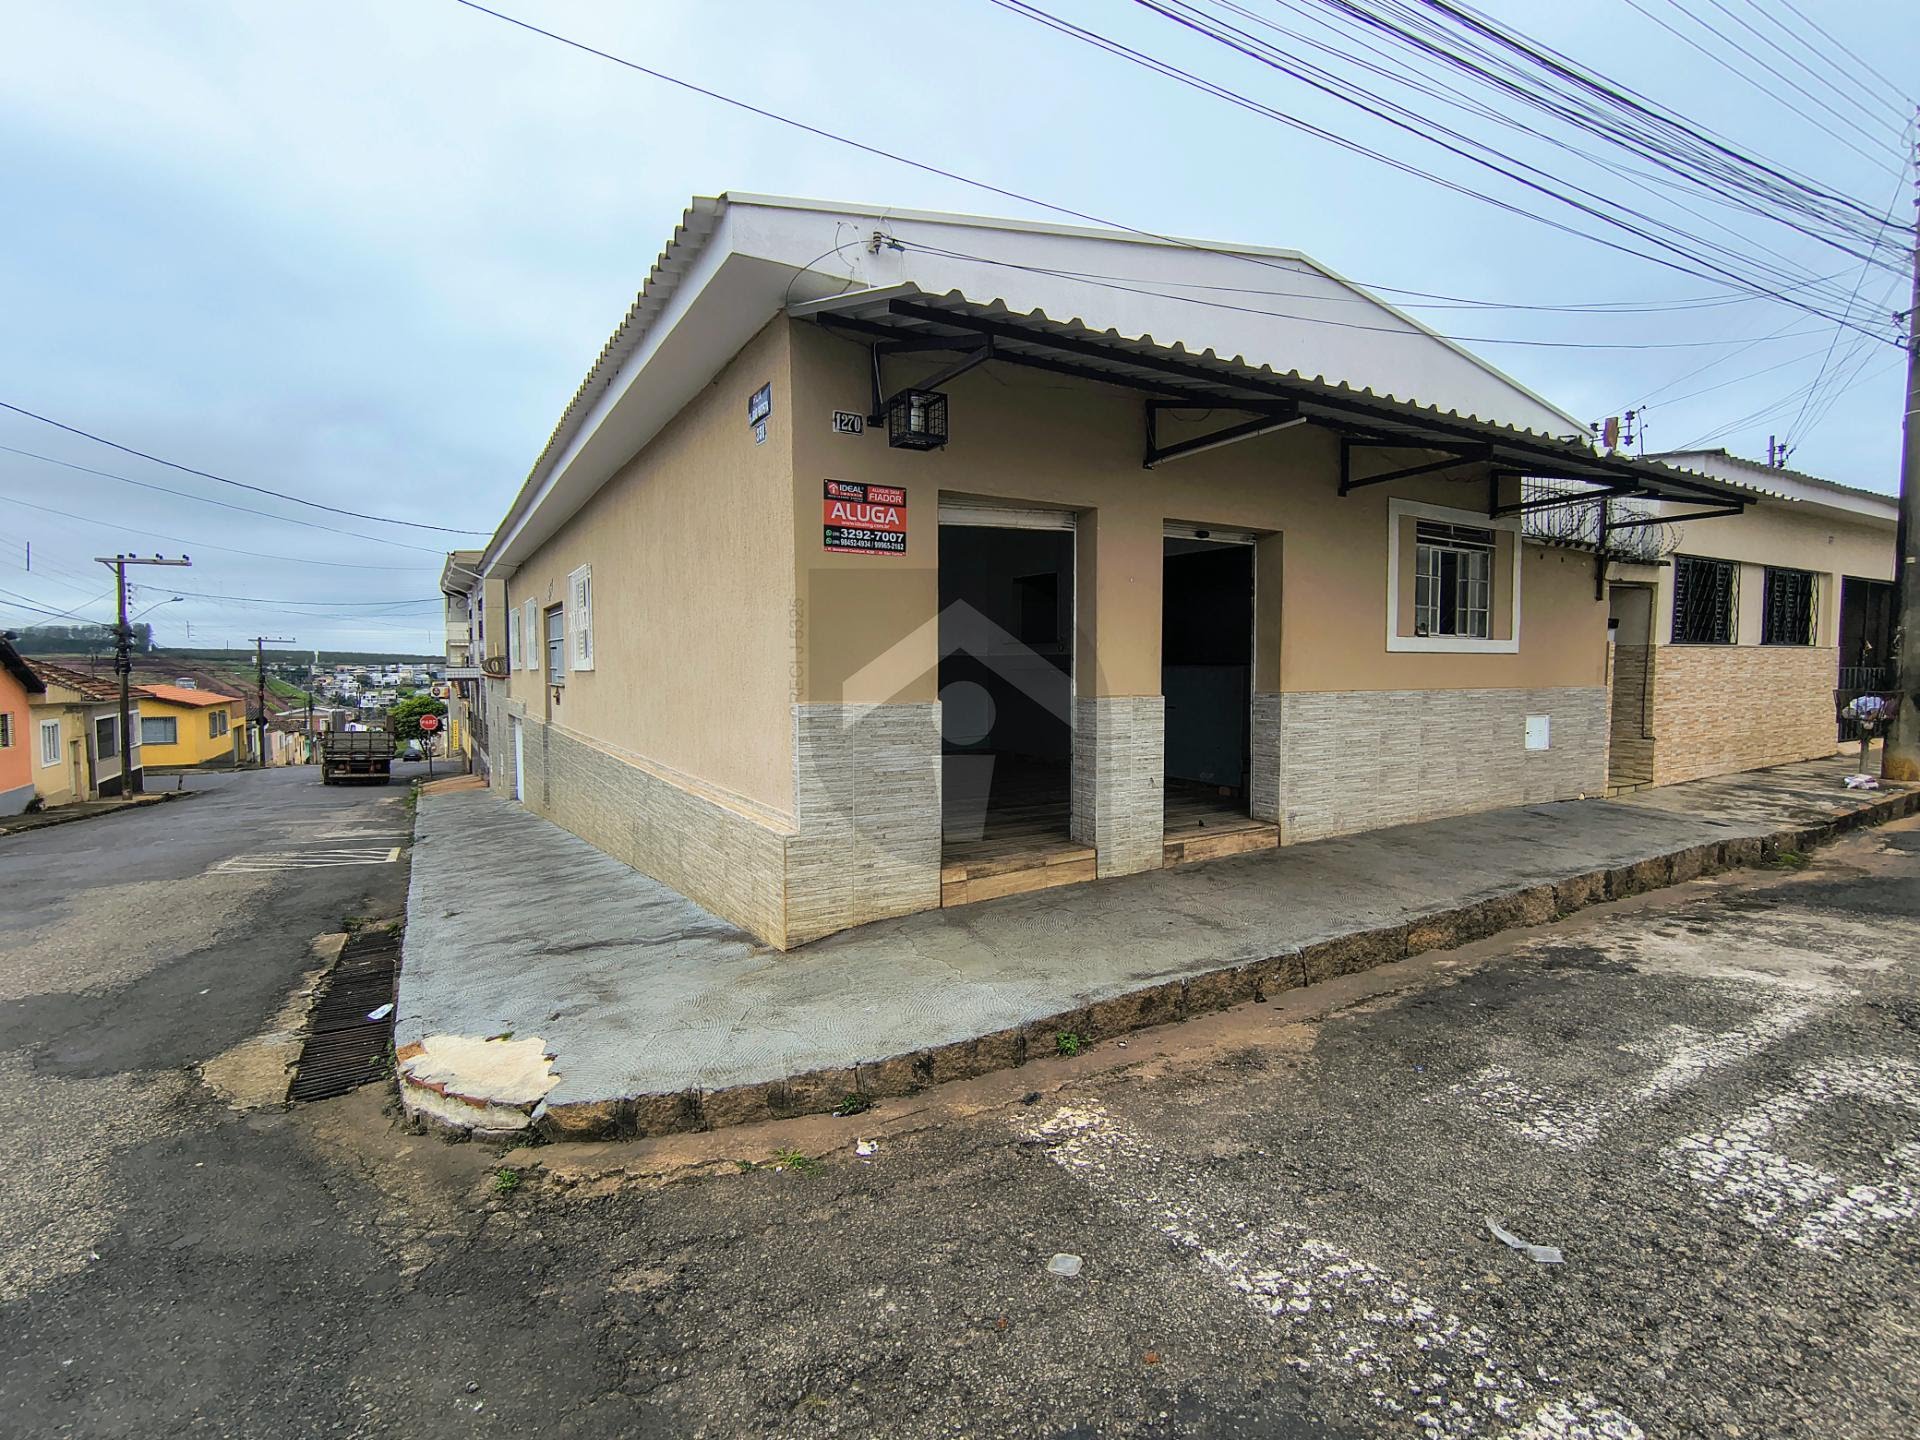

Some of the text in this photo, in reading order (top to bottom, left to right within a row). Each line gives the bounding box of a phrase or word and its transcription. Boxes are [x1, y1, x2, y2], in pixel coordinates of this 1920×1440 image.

[835, 413, 861, 432] 1270
[839, 484, 863, 494] IDEAL
[869, 493, 902, 503] FIADOR
[831, 502, 899, 525] ALUGA
[840, 528, 904, 542] 3292-7007
